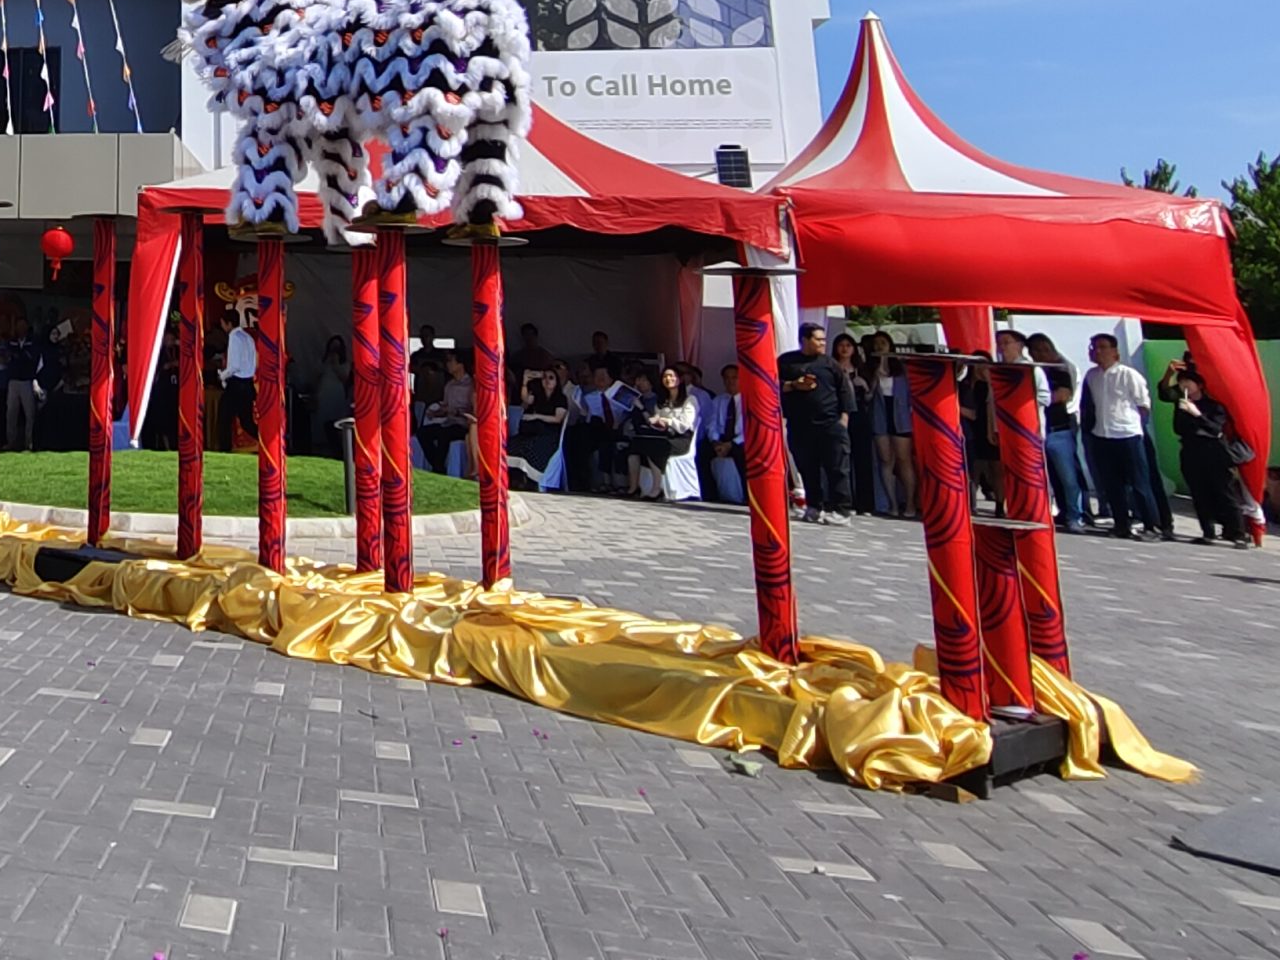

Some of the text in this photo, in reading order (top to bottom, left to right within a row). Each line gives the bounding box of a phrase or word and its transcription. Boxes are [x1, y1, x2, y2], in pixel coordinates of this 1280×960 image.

[541, 73, 732, 98] To Call Home
